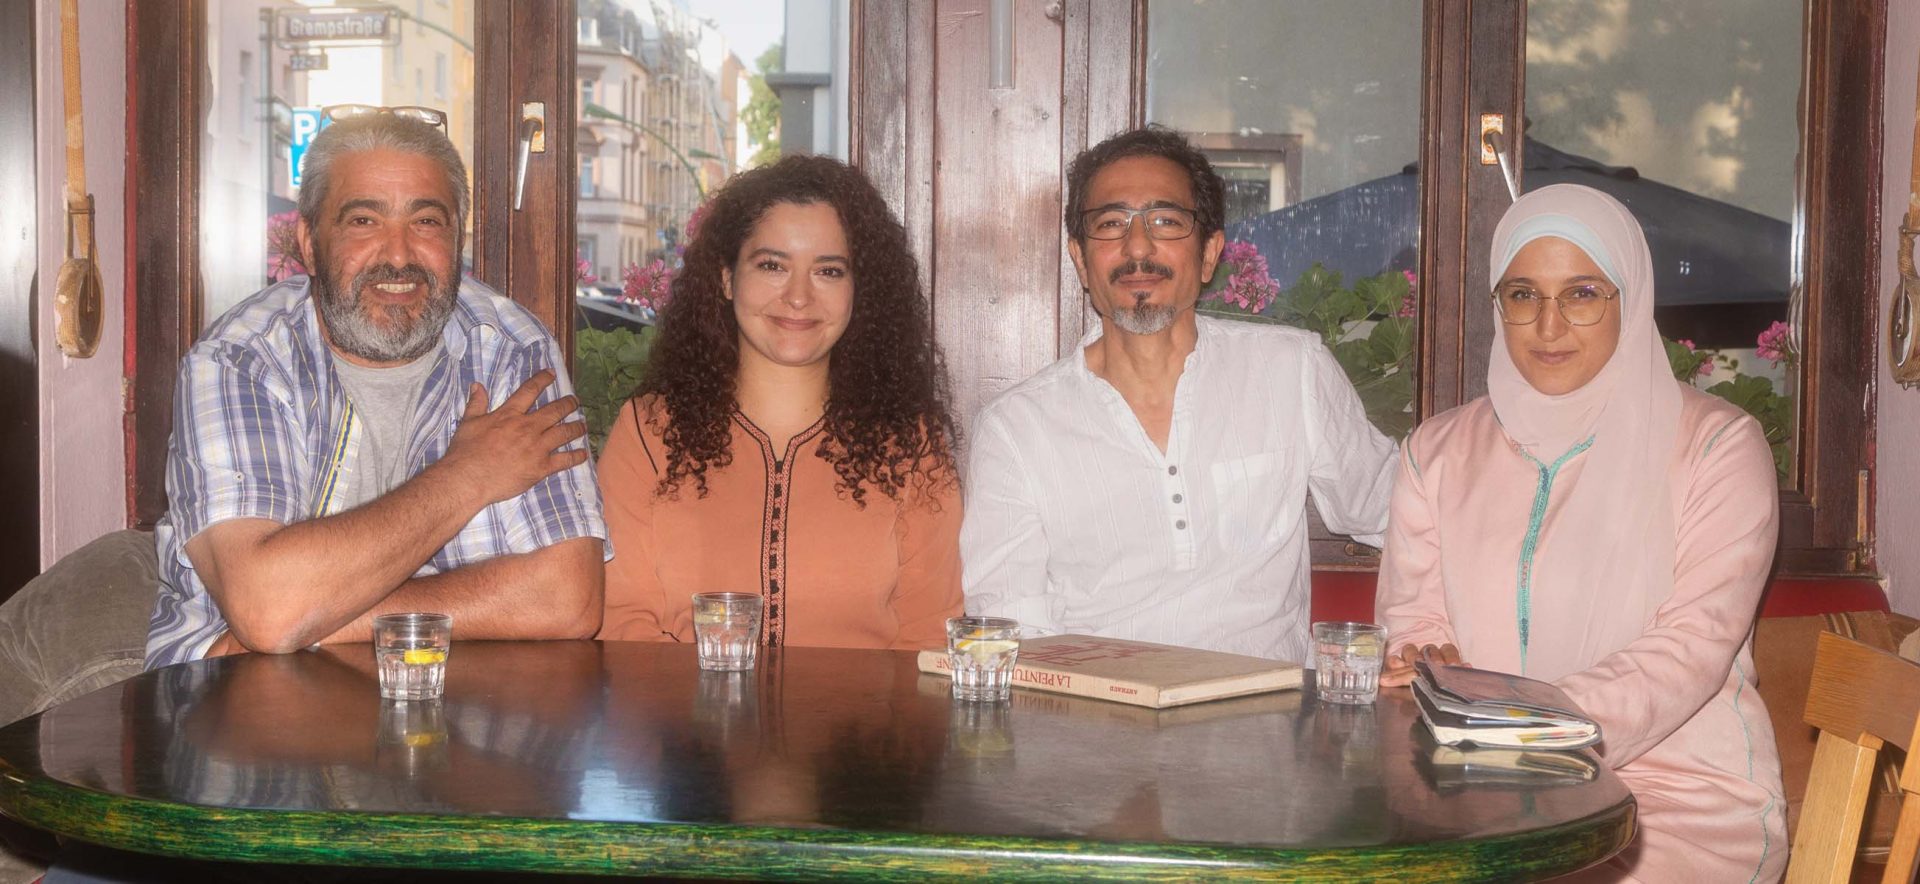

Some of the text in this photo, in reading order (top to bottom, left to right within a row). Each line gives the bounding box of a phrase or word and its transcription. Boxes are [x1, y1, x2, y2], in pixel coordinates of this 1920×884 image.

[290, 16, 383, 38] Grempstraße
[1012, 669, 1071, 688] LA PEINTU
